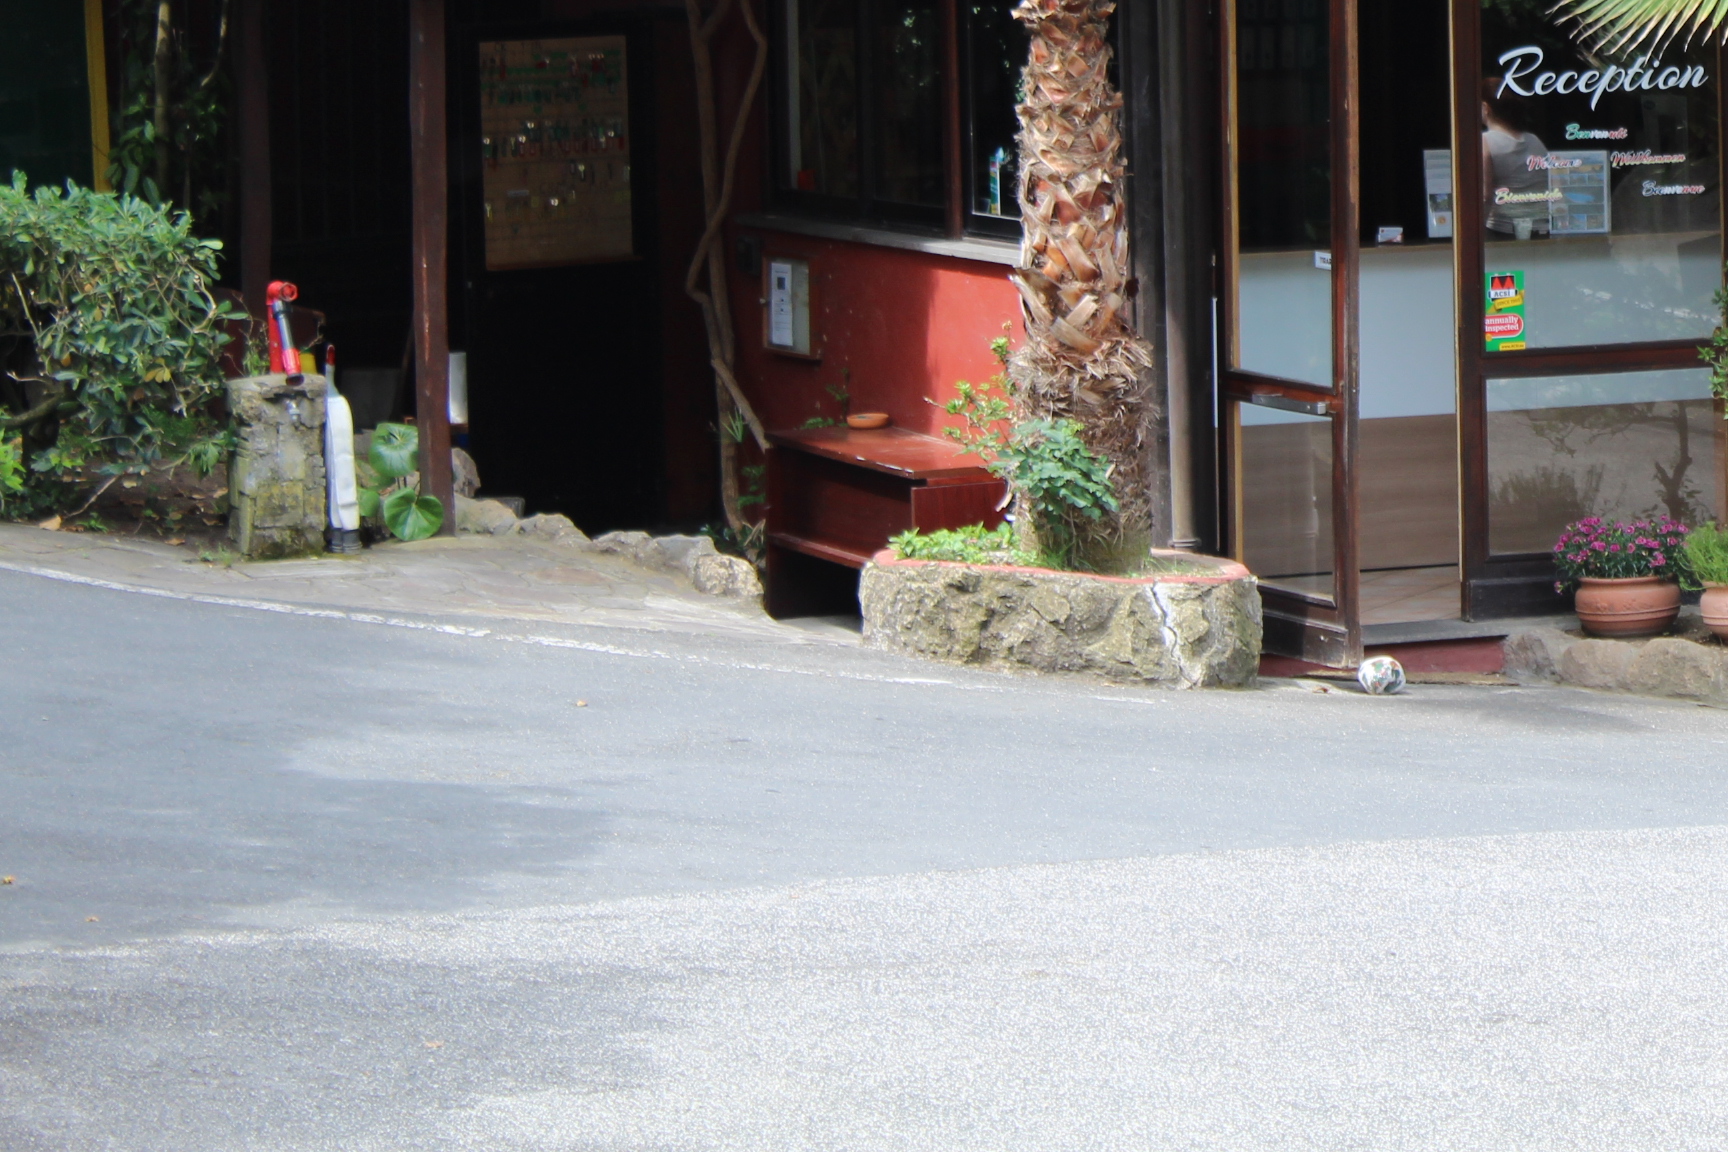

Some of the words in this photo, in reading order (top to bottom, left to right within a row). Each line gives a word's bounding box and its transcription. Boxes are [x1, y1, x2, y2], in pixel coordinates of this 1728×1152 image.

[1496, 44, 1709, 112] Reception
[1565, 123, 1629, 140] Benvenuti
[1527, 153, 1582, 171] Welcome
[1611, 149, 1686, 168] Willkommen
[1642, 179, 1706, 197] Bienvenue
[1493, 287, 1511, 298] ACSI
[1485, 315, 1519, 325] annually
[1485, 323, 1519, 332] inspected
